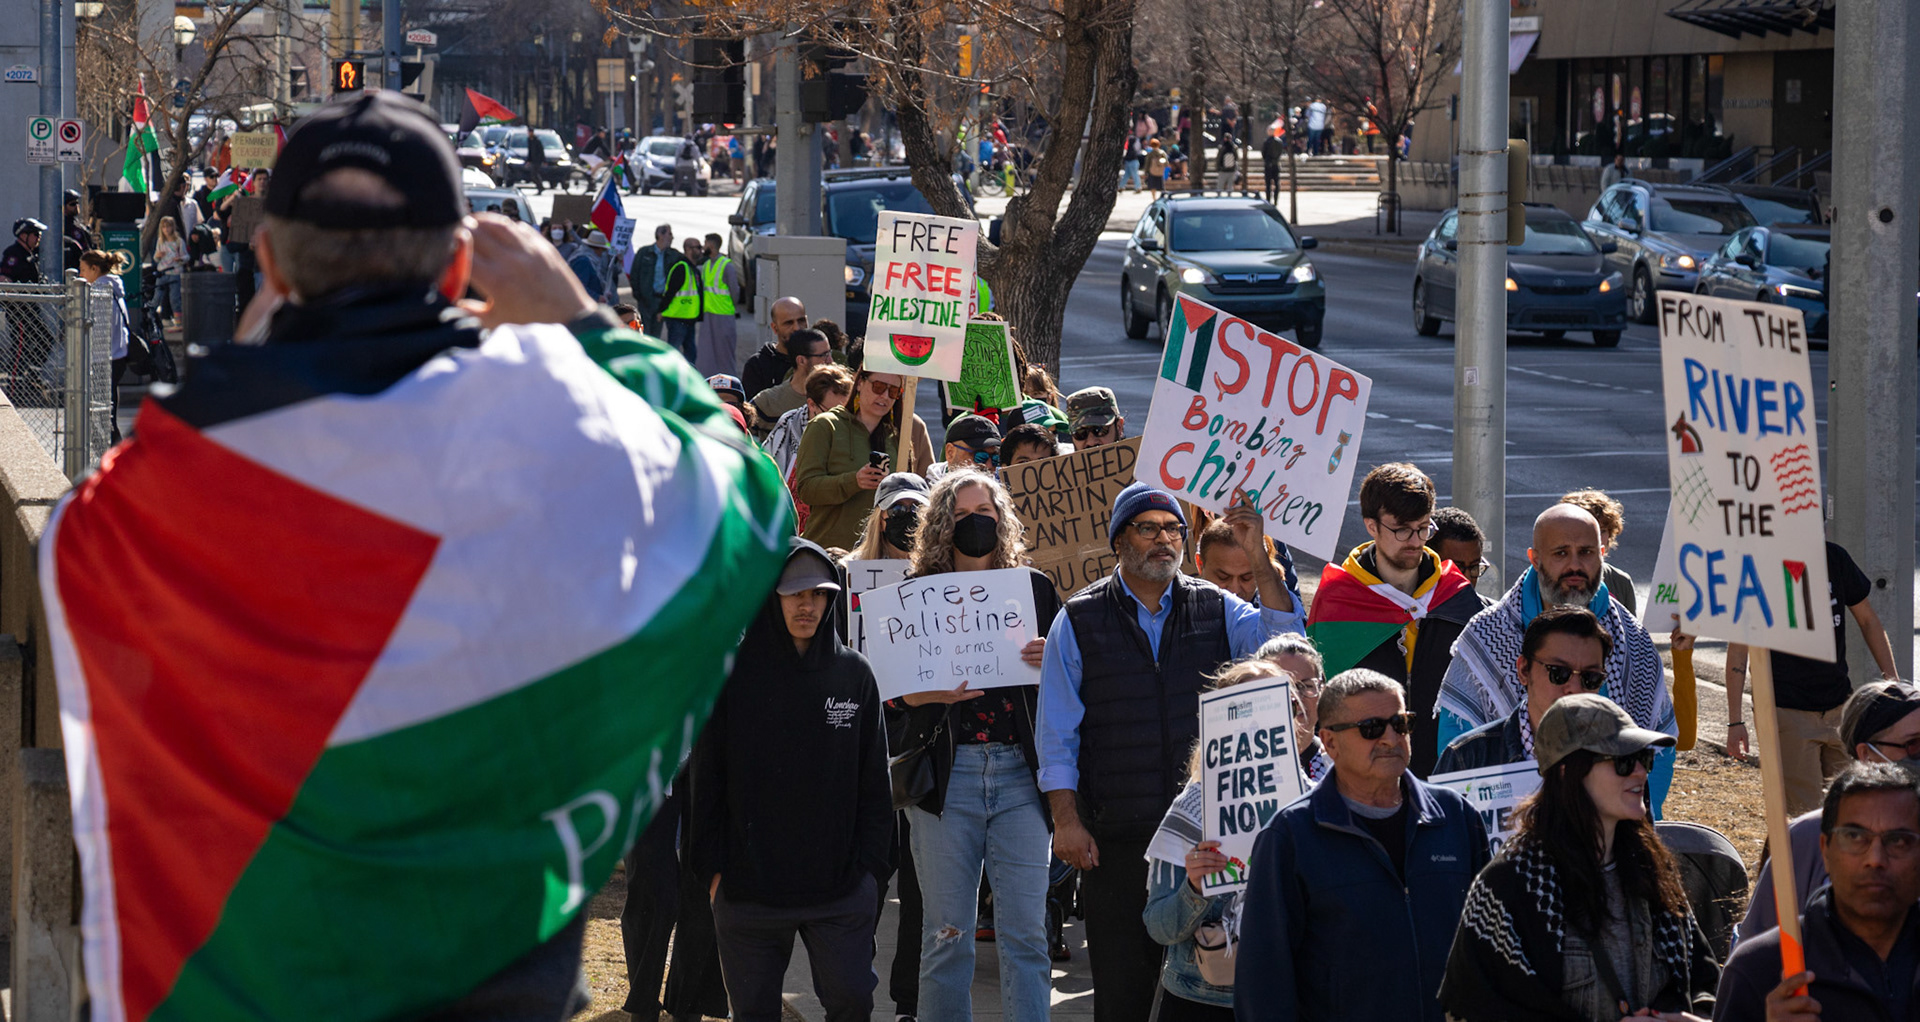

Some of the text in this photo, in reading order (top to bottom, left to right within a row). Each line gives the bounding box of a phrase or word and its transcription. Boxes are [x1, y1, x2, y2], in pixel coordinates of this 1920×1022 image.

[411, 33, 432, 43] 2083
[10, 70, 32, 79] 2072
[37, 122, 48, 136] P
[234, 135, 274, 146] PERMANENT
[247, 159, 263, 167] NOW
[615, 224, 634, 233] CEASE
[616, 232, 630, 240] FIRE
[616, 239, 628, 247] NOW
[892, 220, 964, 254] FREE
[884, 261, 963, 298] FREE
[871, 293, 963, 329] PALESTINE
[1660, 297, 1803, 355] FROM THE
[1214, 317, 1360, 436] STOP
[1683, 356, 1807, 437] RIVER
[1181, 395, 1307, 471] Bombing
[1002, 444, 1137, 498] LOCKHEED
[1159, 438, 1323, 536] Children
[1725, 450, 1761, 492] TO
[1013, 483, 1108, 521] MARTIN
[1716, 498, 1776, 538] THE
[866, 569, 883, 590] I
[897, 579, 989, 611] Free
[1038, 562, 1075, 592] OU
[1655, 582, 1680, 605] PAL
[1678, 541, 1775, 628] SEA
[886, 605, 1026, 644] Palistine.
[918, 640, 994, 659] No arms
[916, 655, 1004, 682] to Israel.
[1205, 724, 1288, 770] CEASE
[1217, 762, 1277, 802] FIRE
[1218, 798, 1279, 837] NOW
